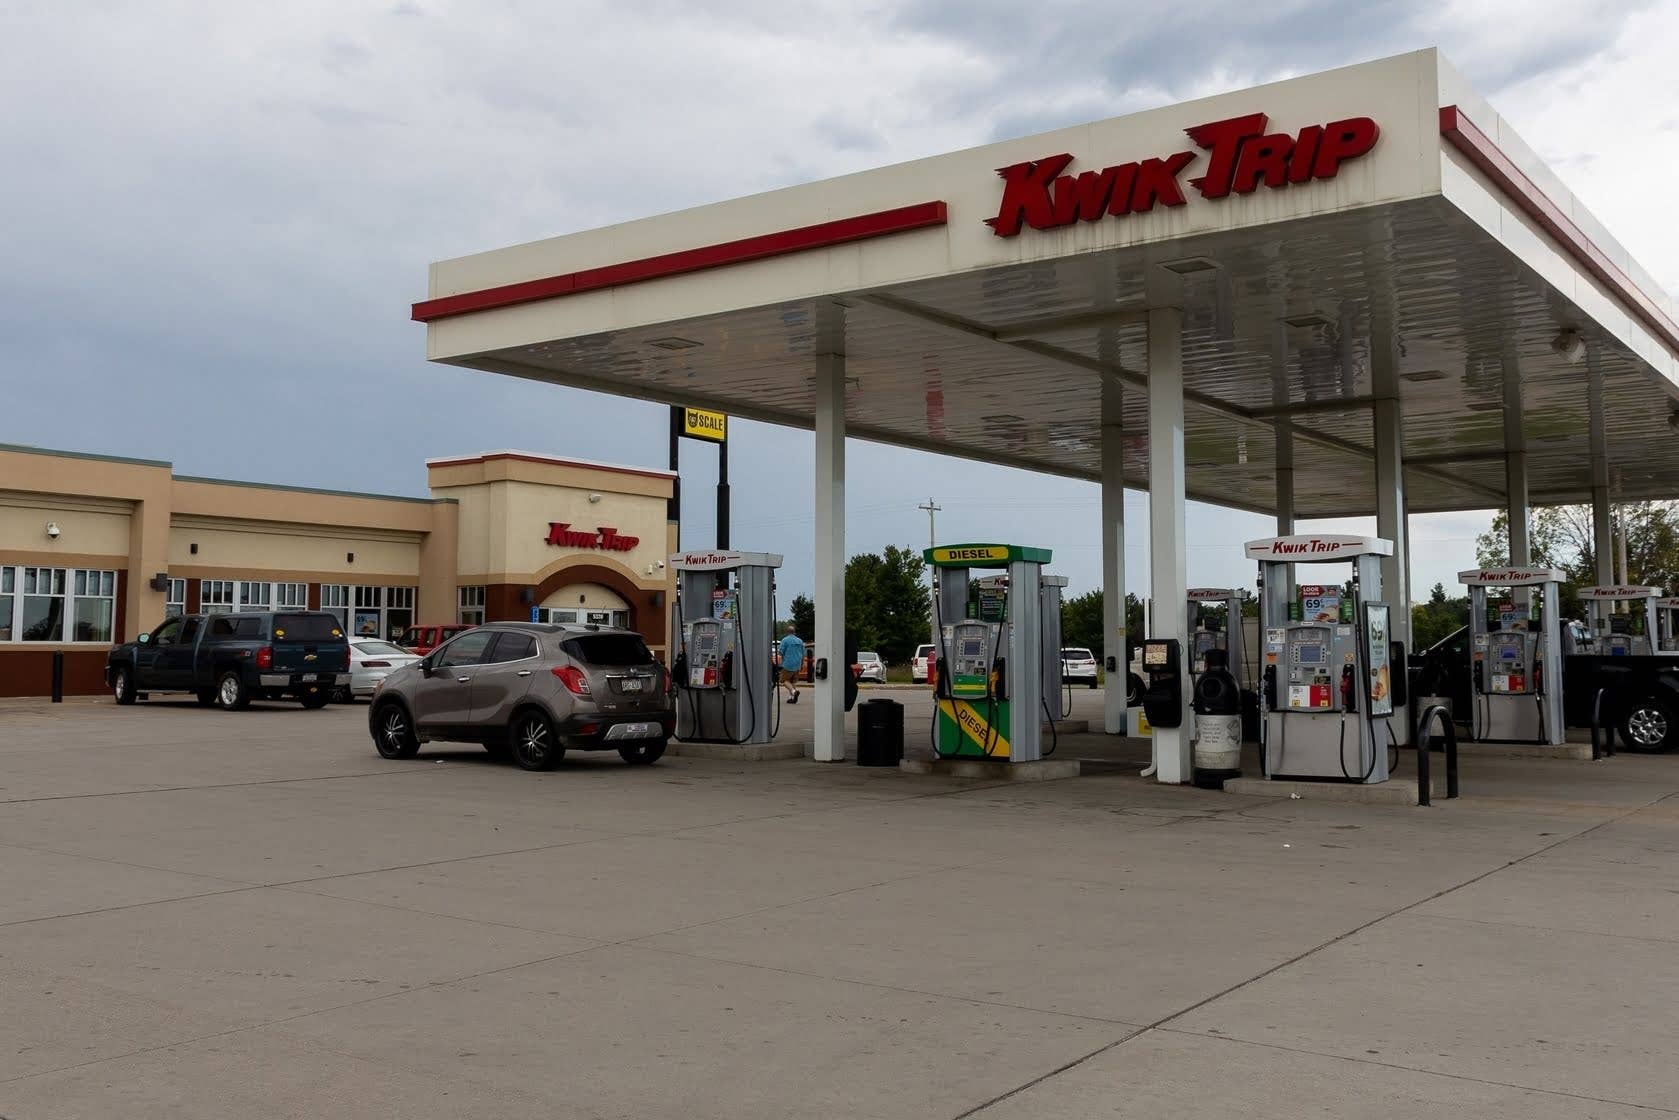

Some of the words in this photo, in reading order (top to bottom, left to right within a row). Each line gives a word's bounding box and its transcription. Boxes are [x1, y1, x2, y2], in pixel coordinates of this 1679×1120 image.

[984, 153, 1197, 238] KWIK
[1183, 112, 1380, 201] TRIP
[698, 414, 723, 431] SCALE
[949, 549, 994, 560] DIESEL
[1272, 541, 1308, 554] KWIK
[1310, 540, 1340, 553] TRIP
[685, 555, 707, 565] KWIK
[707, 554, 727, 564] TRIP
[959, 709, 990, 742] DIESE
